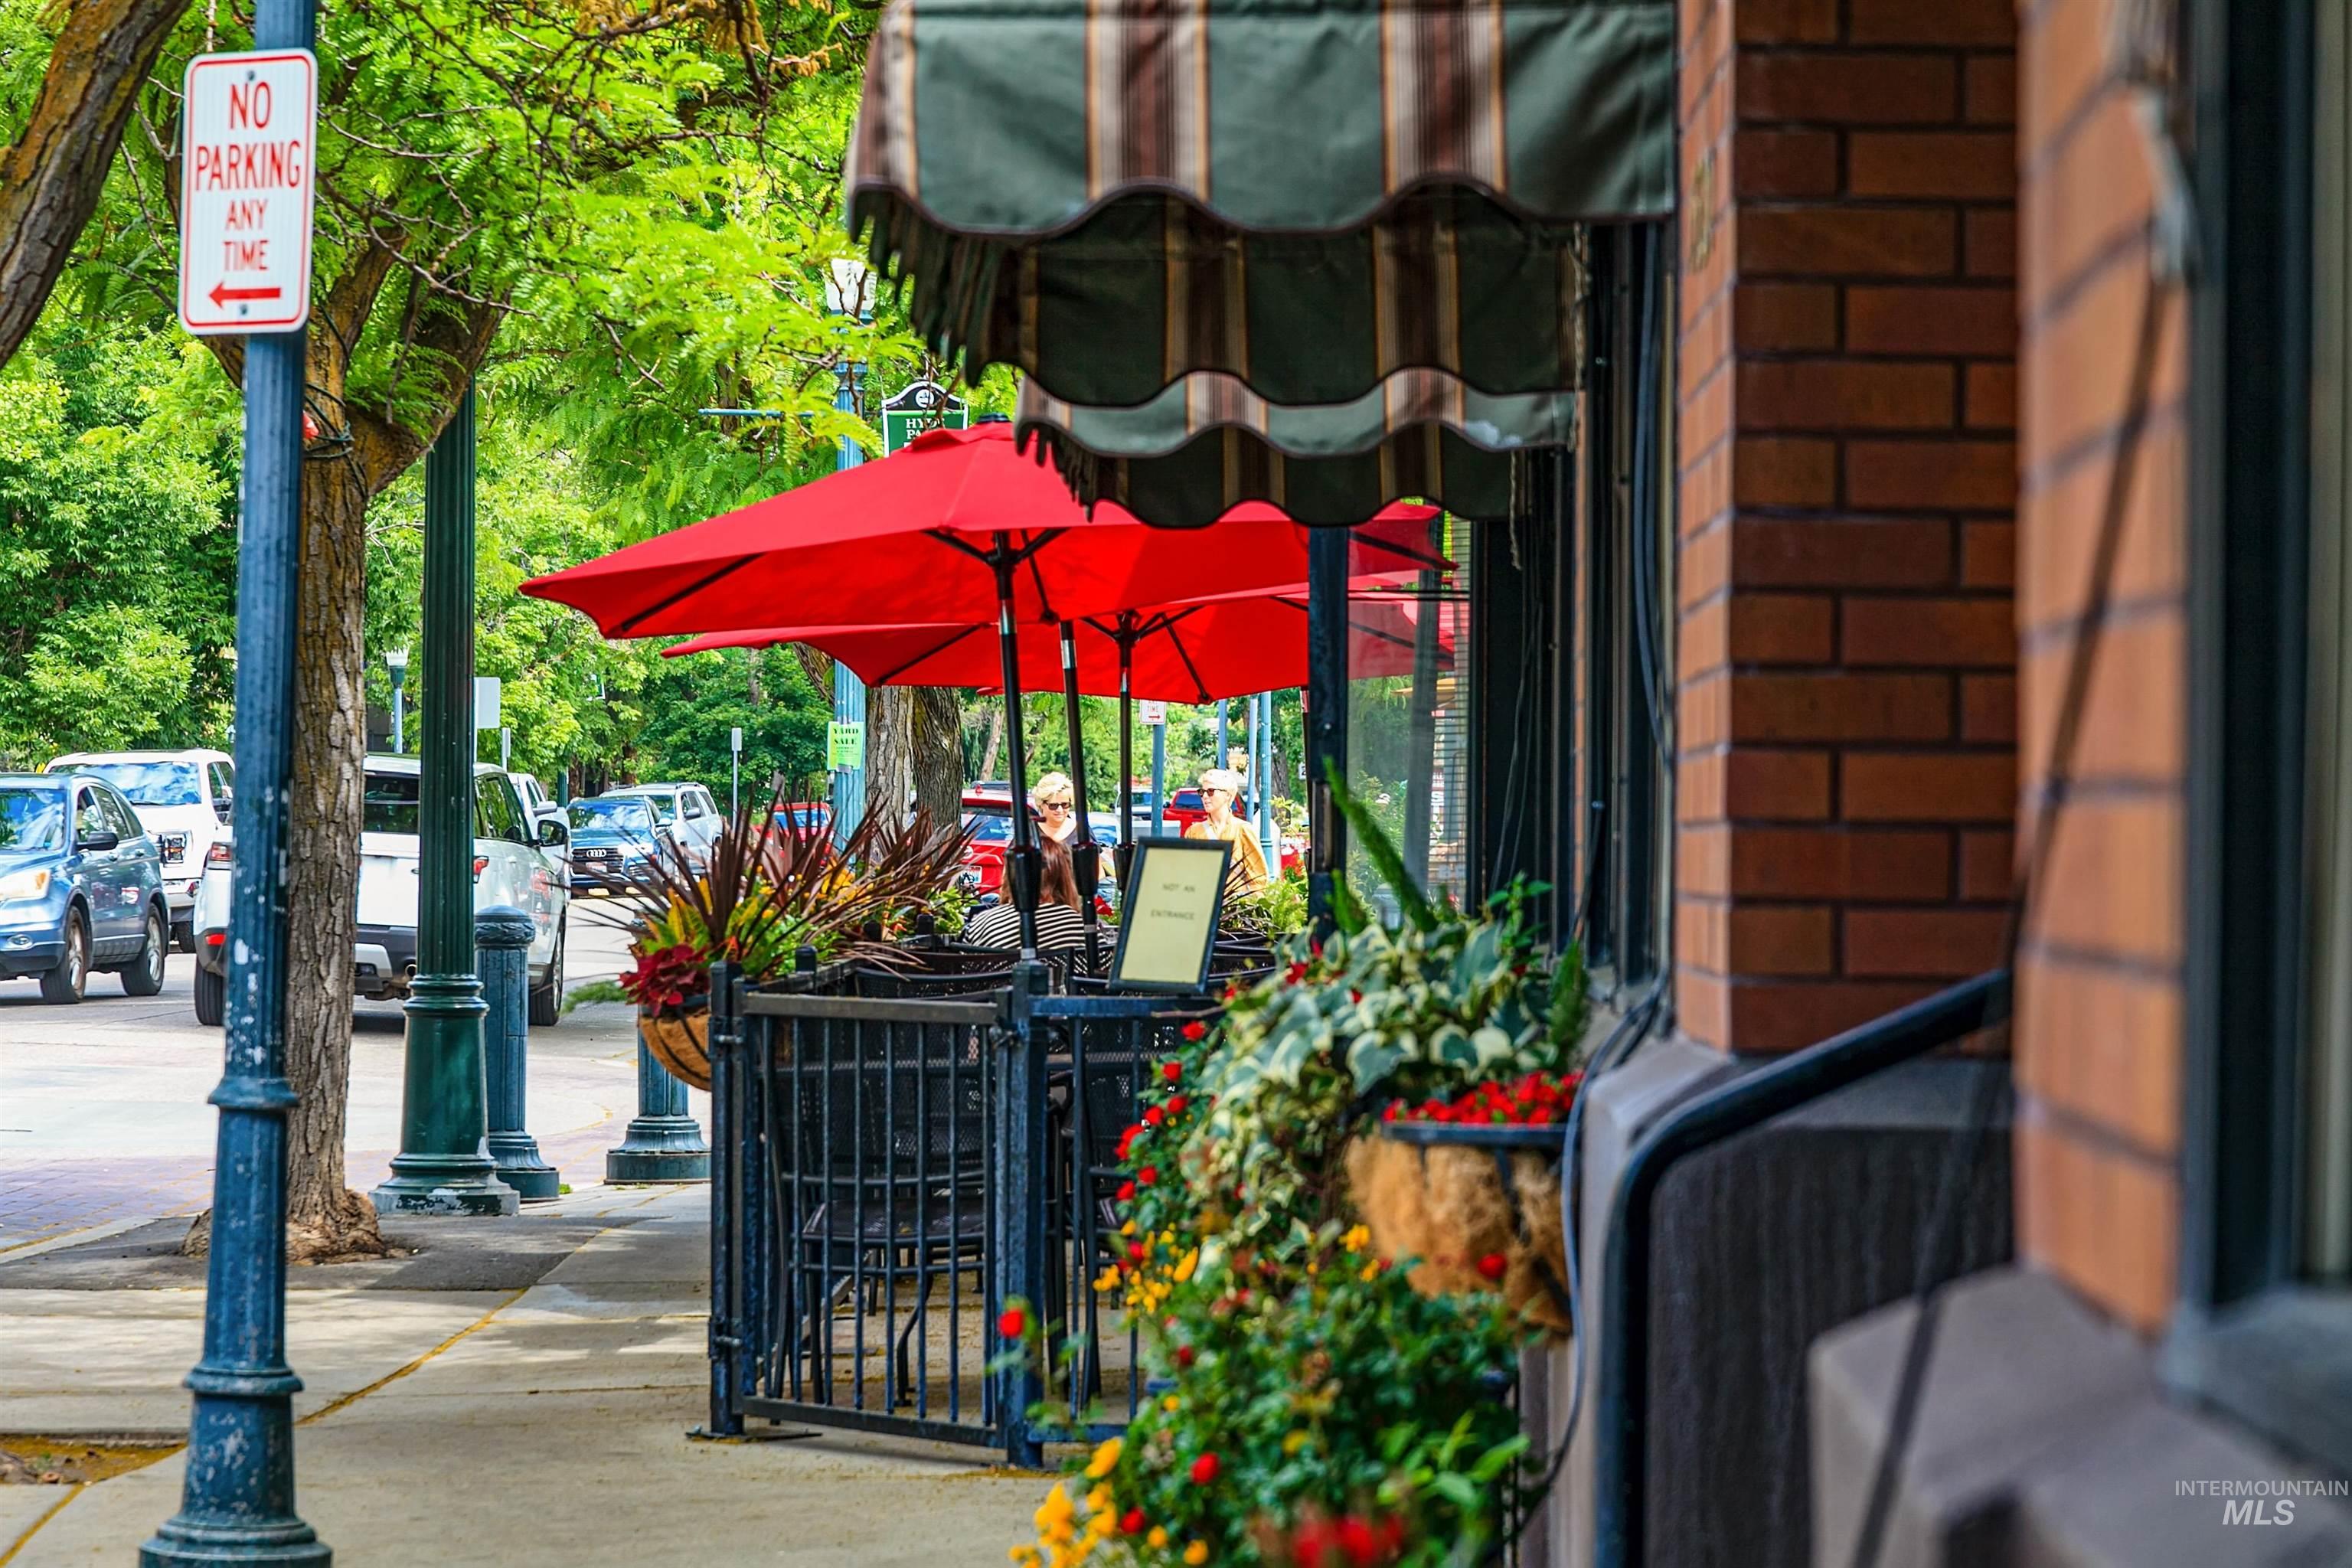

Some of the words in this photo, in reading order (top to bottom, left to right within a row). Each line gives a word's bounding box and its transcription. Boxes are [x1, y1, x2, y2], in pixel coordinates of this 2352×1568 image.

[228, 80, 272, 129] NO
[194, 139, 301, 191] PARKING
[224, 198, 269, 231] ANY
[222, 239, 270, 272] TIME
[906, 418, 945, 429] HYD
[1162, 883, 1179, 891] NOT
[1151, 909, 1195, 920] ENTRANCE
